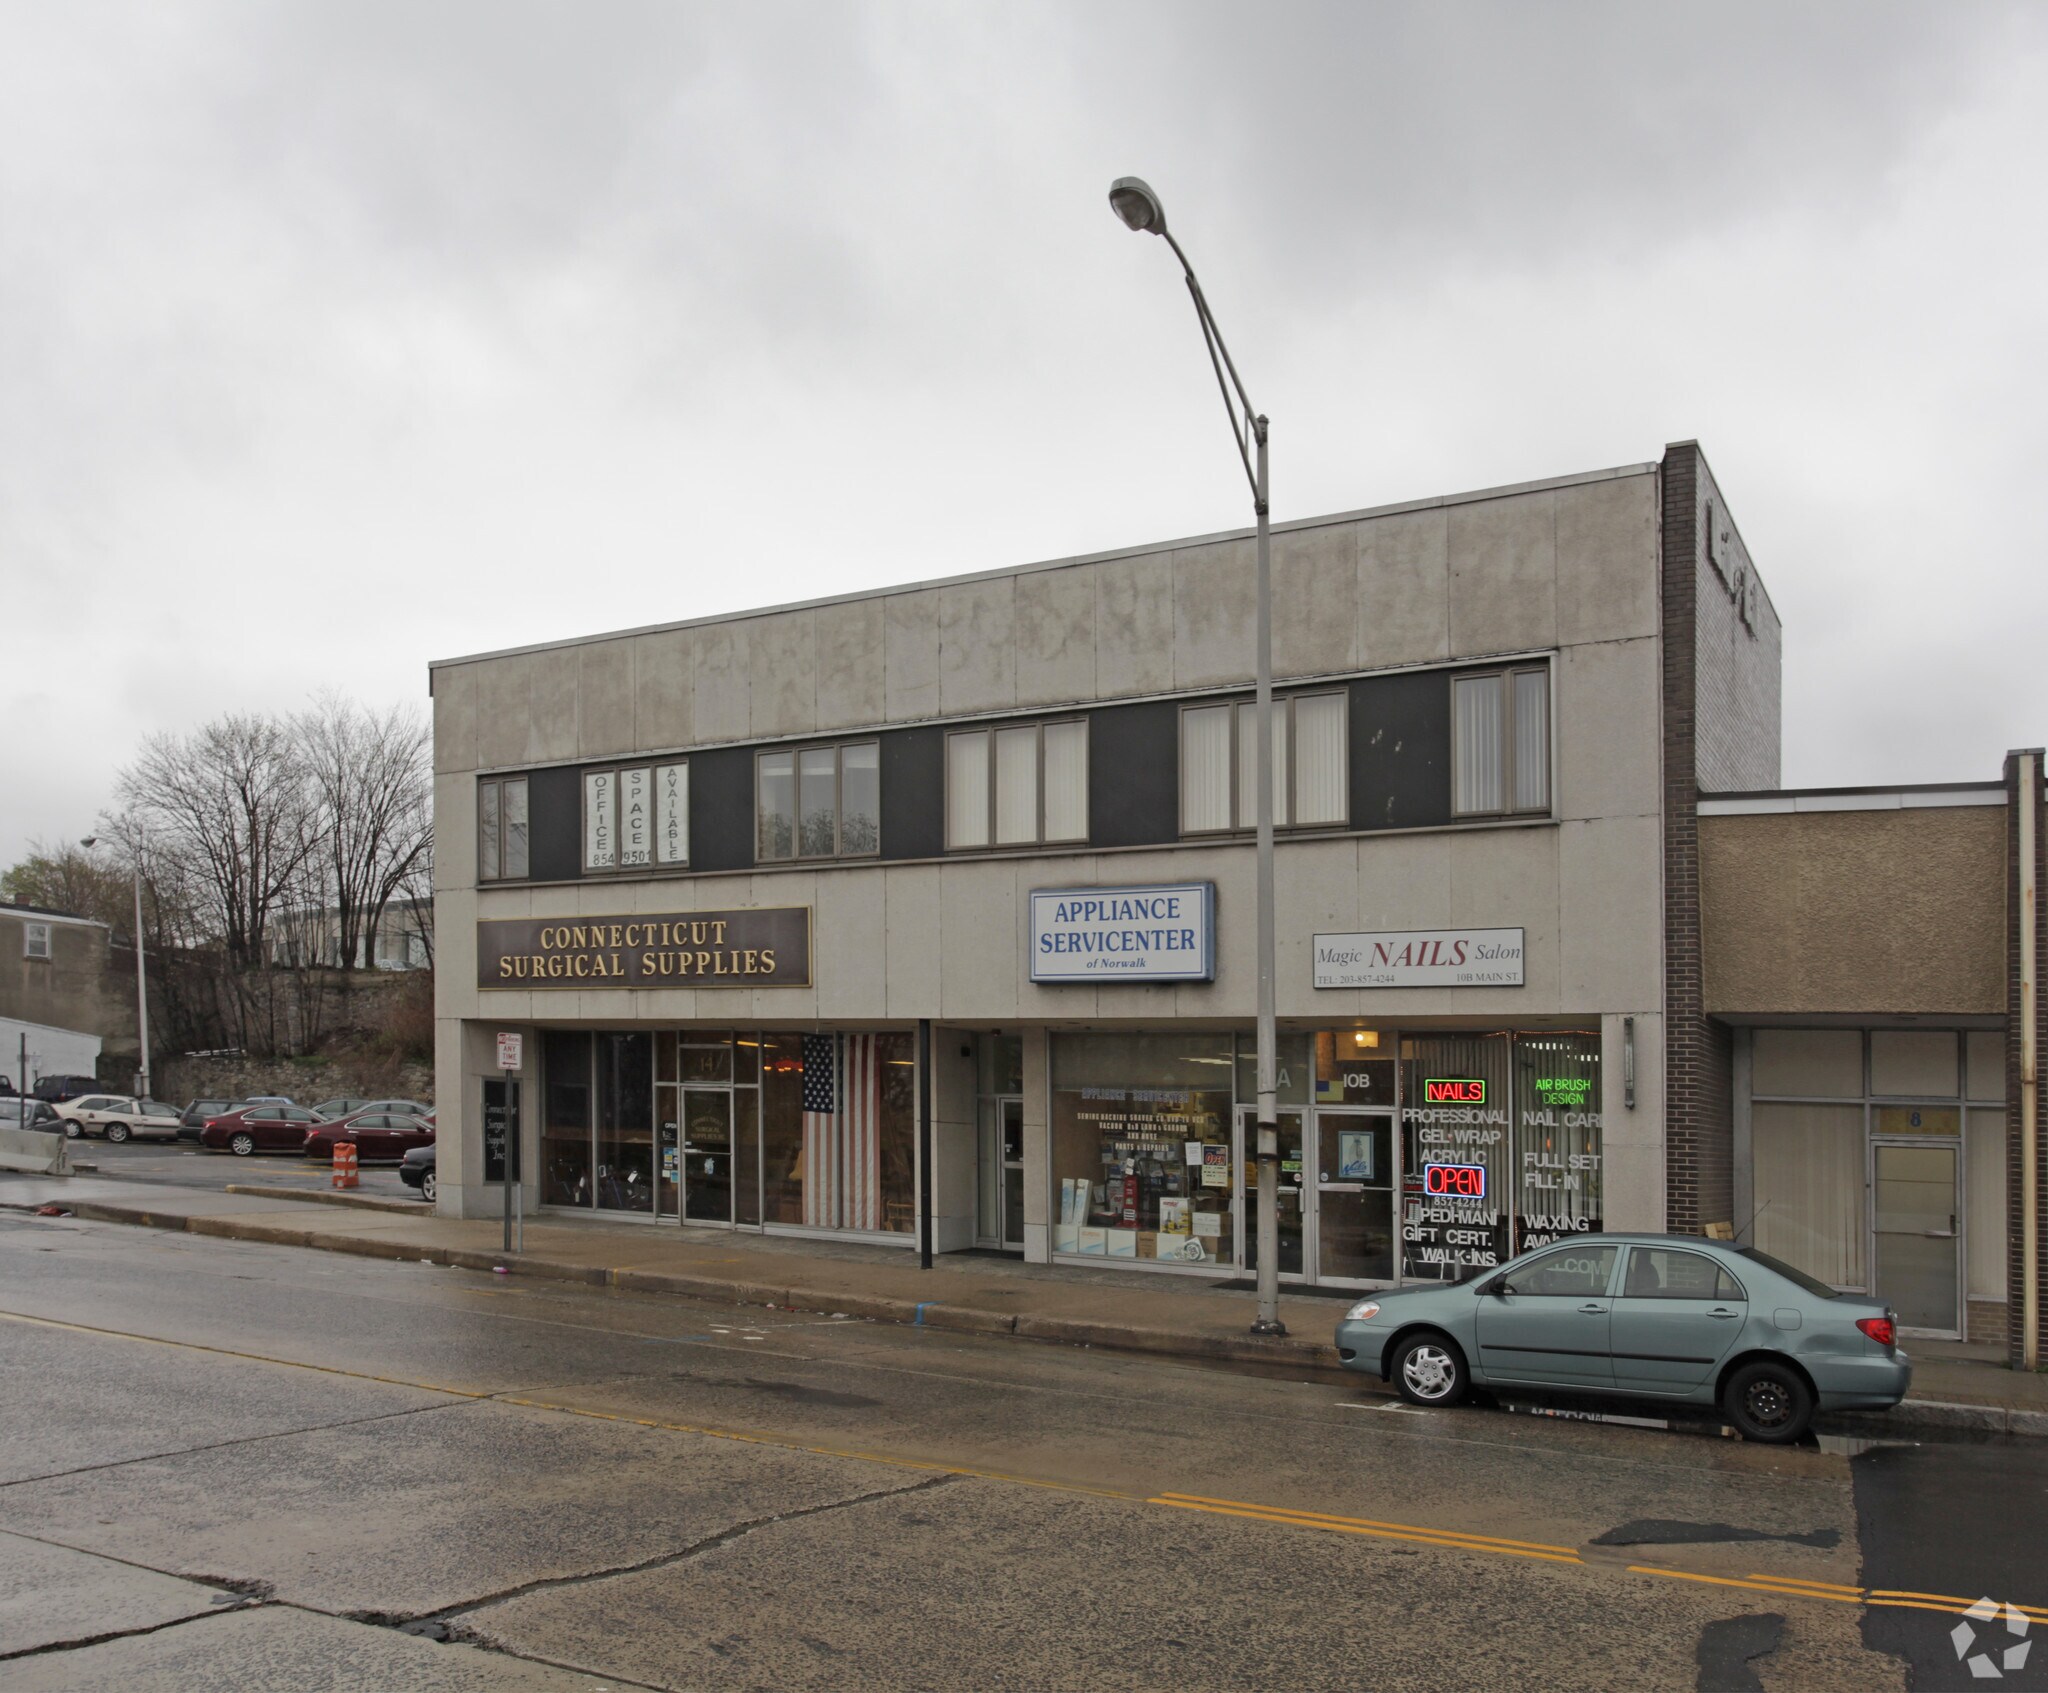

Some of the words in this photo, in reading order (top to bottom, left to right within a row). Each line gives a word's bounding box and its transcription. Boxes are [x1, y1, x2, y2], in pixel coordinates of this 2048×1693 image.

[595, 776, 607, 850] OFFICE
[630, 772, 643, 844] SPACE
[667, 768, 678, 860] AVAILABLE
[593, 853, 615, 866] 854
[623, 849, 652, 864] 9501
[1054, 897, 1181, 923] APPLIANCE
[540, 920, 728, 950] CONNECTICUT
[1040, 929, 1196, 954] SERVICENTER
[1086, 958, 1099, 969] of
[1100, 957, 1147, 969] Norwalk
[1317, 947, 1362, 967] Magic
[1369, 939, 1470, 968] NAILS
[1475, 943, 1520, 960] Salon
[499, 952, 625, 979] SURGICAL
[642, 949, 777, 976] SUPPLIES
[1318, 975, 1338, 985] TEL:
[1339, 974, 1395, 984] 203-857-4244
[1456, 973, 1473, 982] 10B
[1475, 972, 1503, 982] MAIN
[1505, 972, 1520, 982] ST.
[1428, 1082, 1482, 1100] NAILS
[1535, 1079, 1552, 1091] AIR
[1554, 1079, 1591, 1091] BRUSH
[1543, 1093, 1585, 1105] DESIGN
[1402, 1106, 1509, 1125] PROFESSIONAL
[1523, 1108, 1559, 1126] NAIL
[1909, 1111, 1922, 1128] 8
[1419, 1129, 1450, 1144] GEL
[1454, 1129, 1501, 1145] WRAP
[1420, 1148, 1487, 1165] ACRYLIC
[1524, 1151, 1564, 1169] FULL
[1568, 1153, 1601, 1170] SET
[1427, 1167, 1483, 1196] OPEN
[1524, 1169, 1579, 1191] FILL-IN
[1434, 1196, 1483, 1209] 857-4244
[1420, 1205, 1497, 1226] PEDI-MANI
[1524, 1212, 1589, 1232] WAXING
[1402, 1224, 1438, 1242] GIFT
[1446, 1229, 1492, 1247] CERT.
